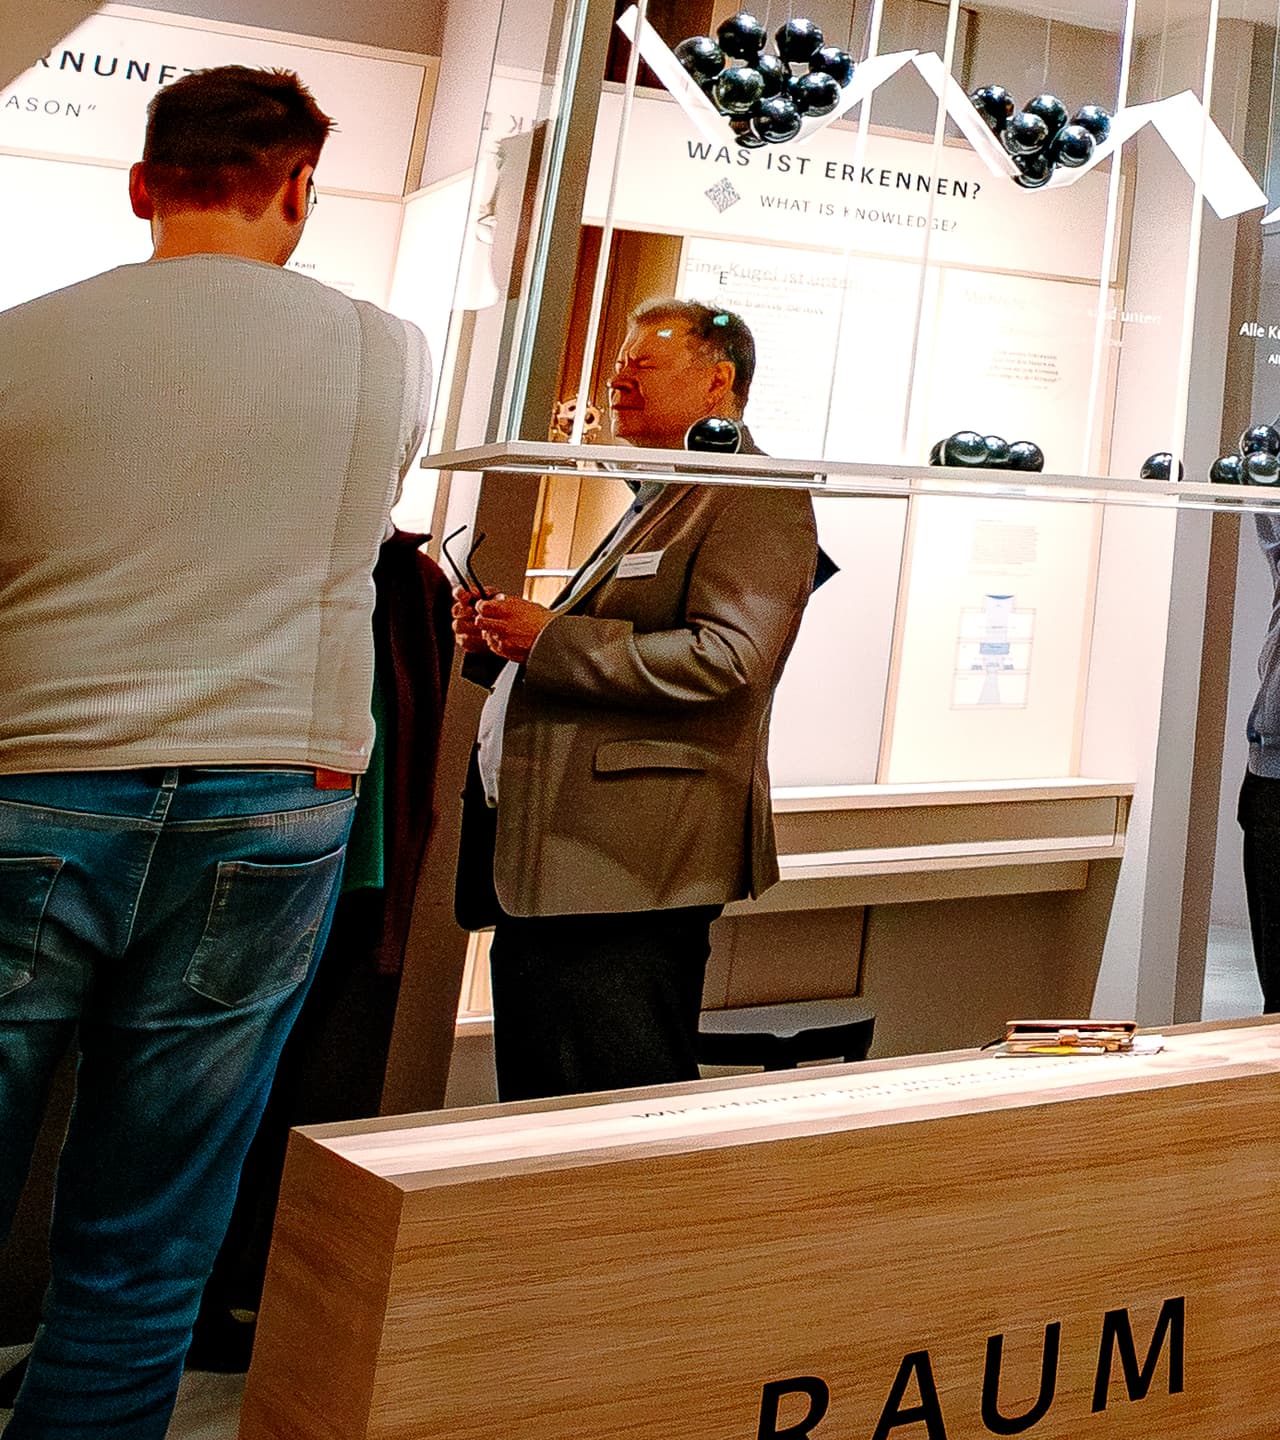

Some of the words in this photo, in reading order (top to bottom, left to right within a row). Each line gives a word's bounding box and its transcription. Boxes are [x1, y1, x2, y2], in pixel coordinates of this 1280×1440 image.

[37, 50, 200, 86] NUNF
[686, 139, 752, 167] WAS
[766, 152, 812, 177] IST
[823, 160, 985, 201] ERKENNEN?
[759, 194, 812, 215] WHAT
[818, 202, 835, 218] IS
[684, 256, 722, 274] Eine
[1239, 321, 1265, 338] Alle
[1268, 353, 1280, 366] All
